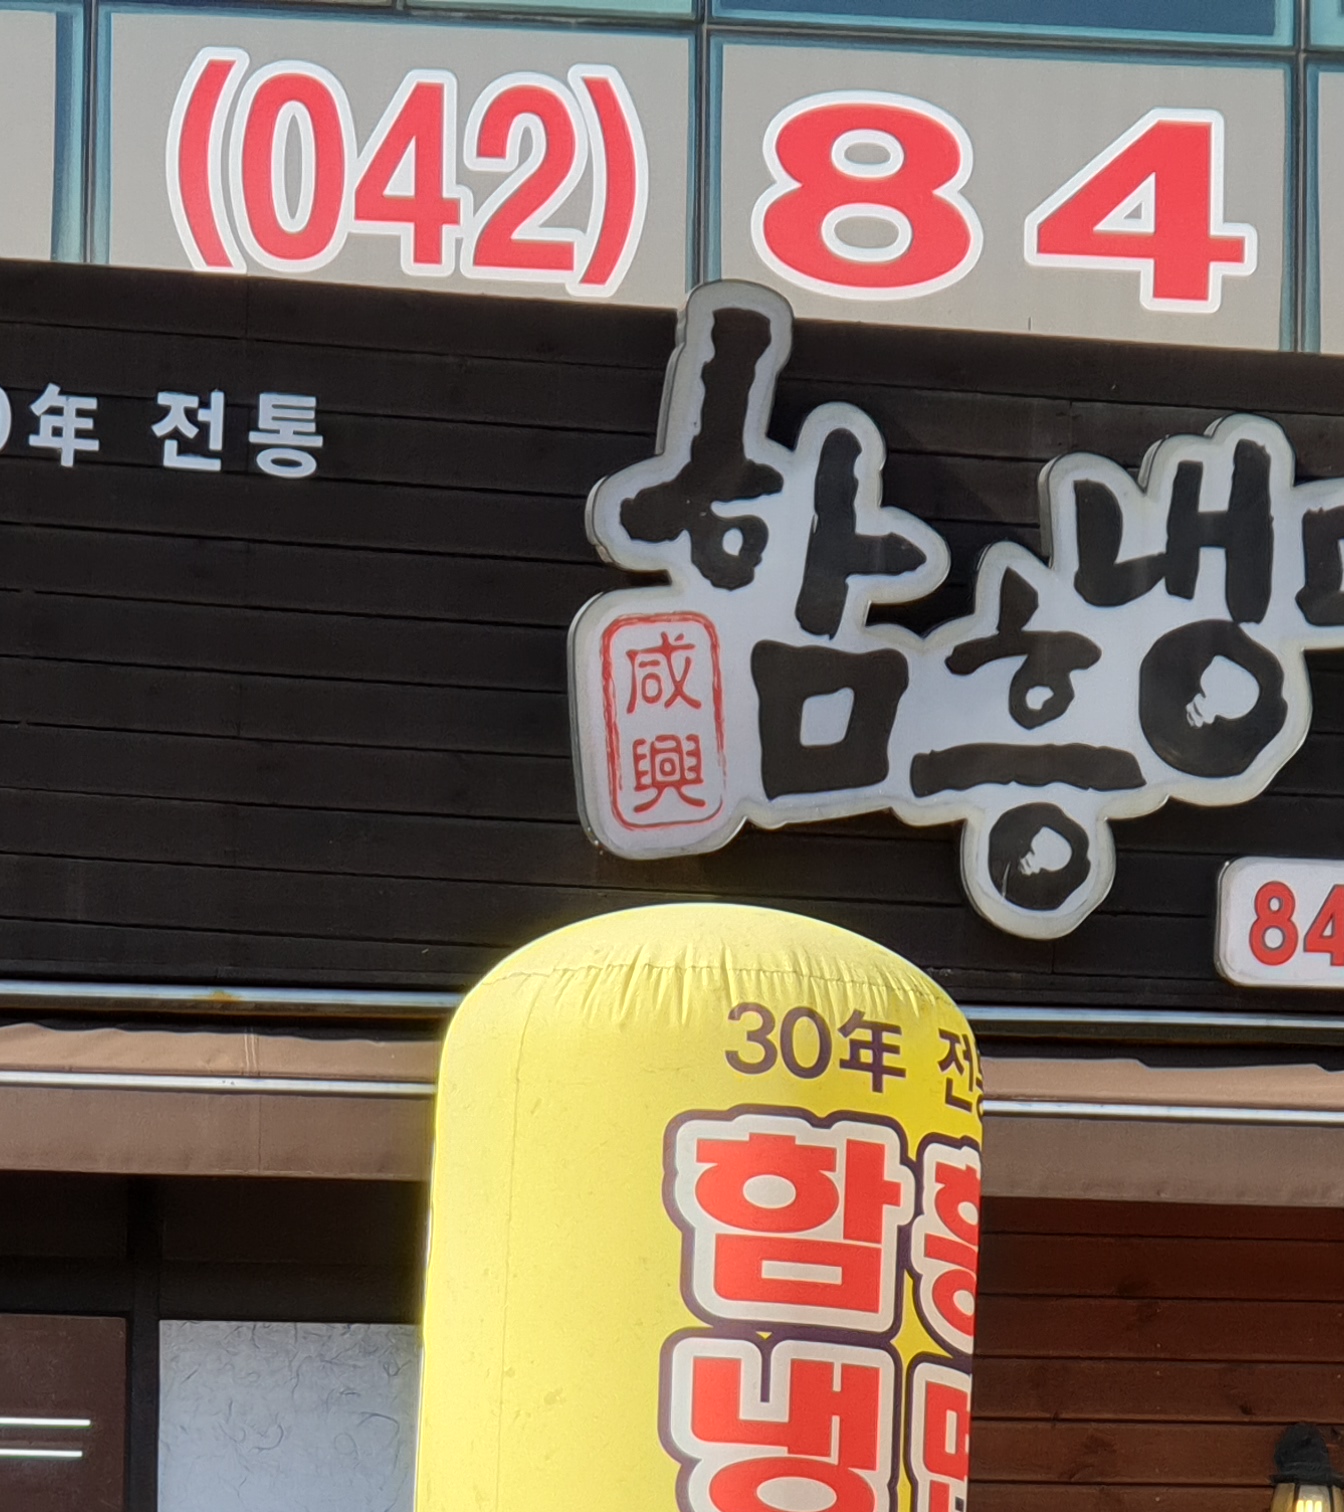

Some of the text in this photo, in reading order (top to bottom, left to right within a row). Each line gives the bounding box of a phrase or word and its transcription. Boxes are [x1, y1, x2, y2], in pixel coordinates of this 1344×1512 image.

[172, 52, 642, 292] (042)
[151, 388, 324, 478] 전통
[936, 1027, 983, 1117] 전
